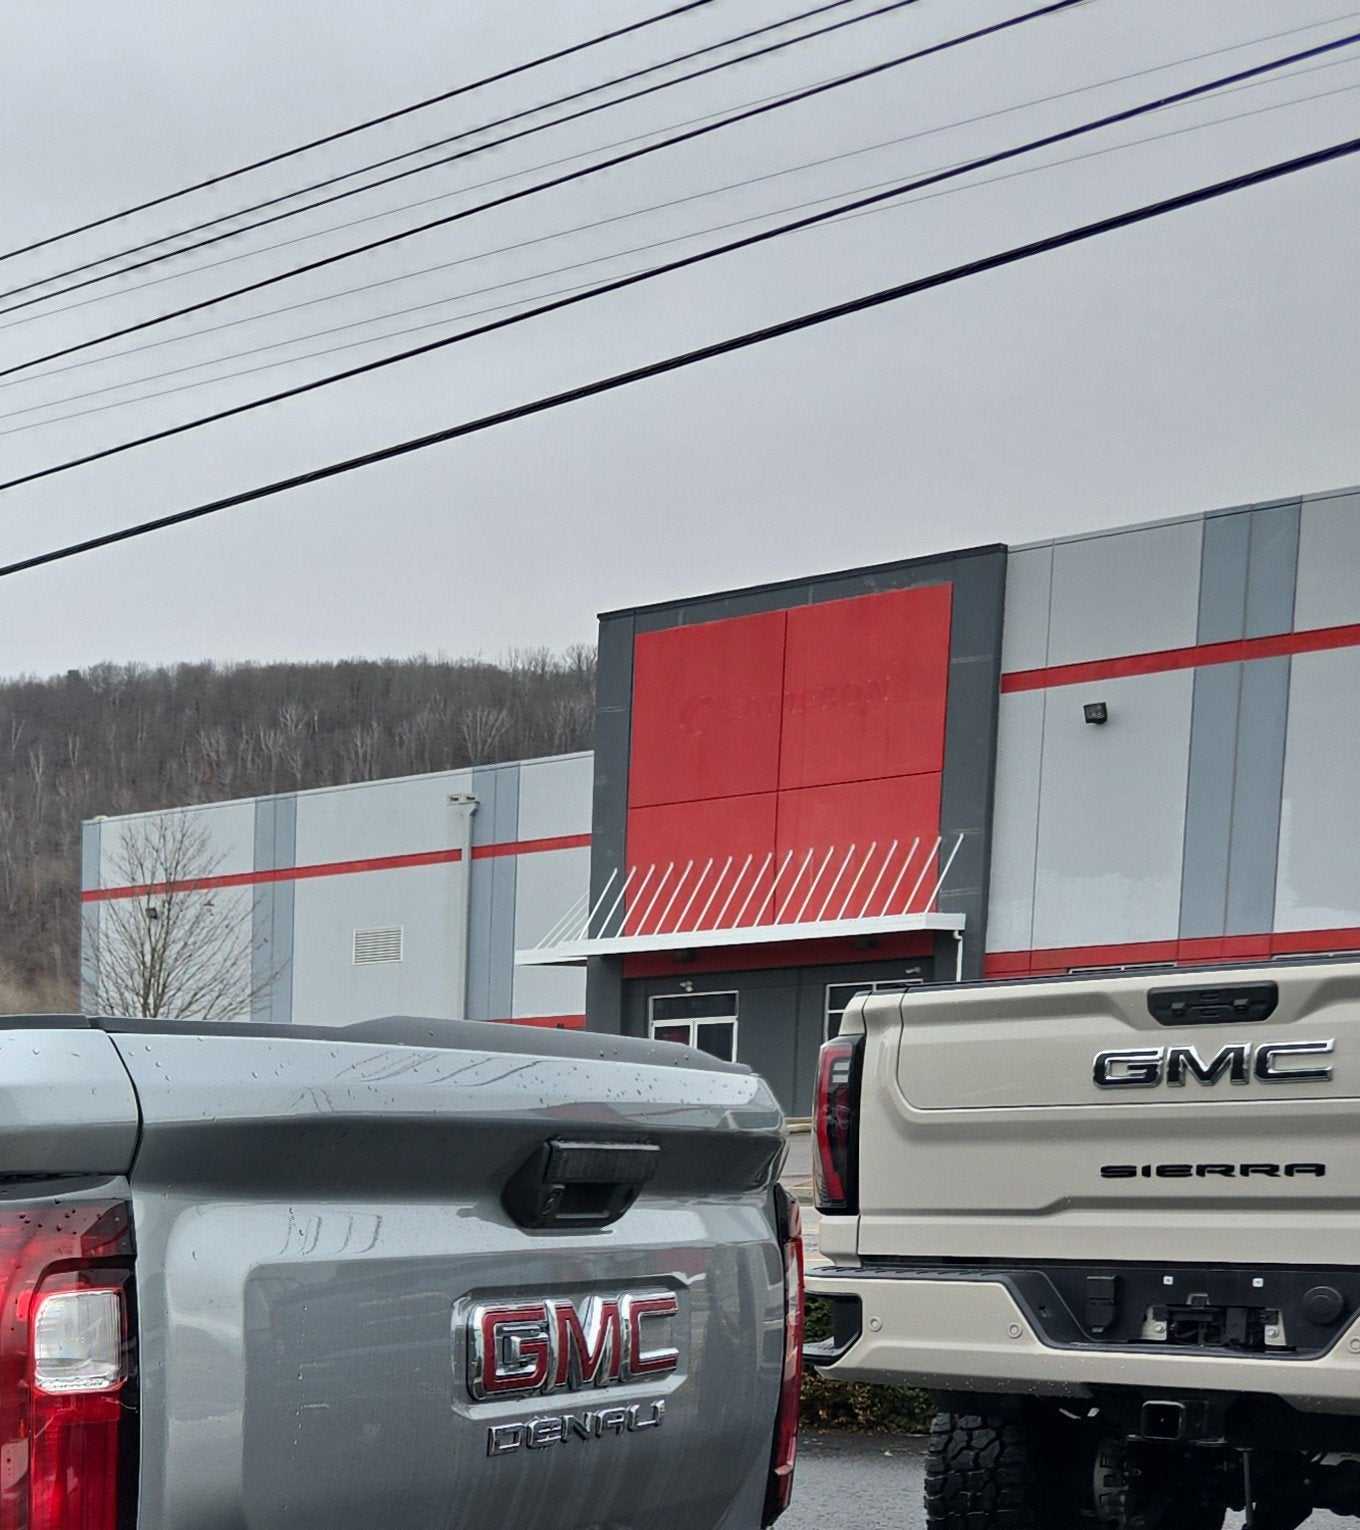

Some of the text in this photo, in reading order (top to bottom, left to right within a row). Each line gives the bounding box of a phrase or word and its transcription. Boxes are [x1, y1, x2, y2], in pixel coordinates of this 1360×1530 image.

[1093, 1038, 1335, 1089] GMC
[1100, 1162, 1326, 1179] SIERRA
[467, 1291, 679, 1399] GMC
[486, 1400, 666, 1457] DENALI
